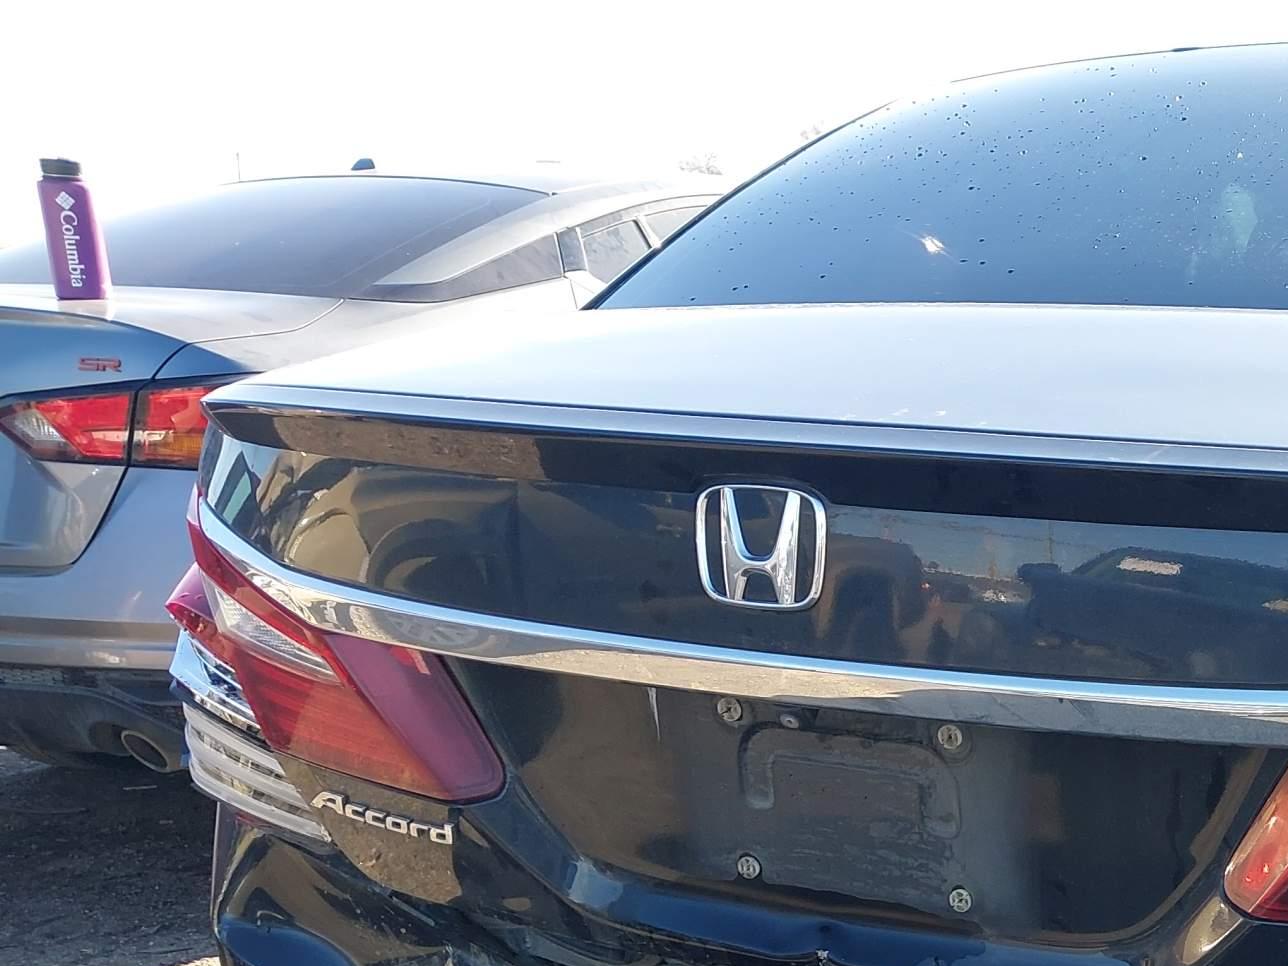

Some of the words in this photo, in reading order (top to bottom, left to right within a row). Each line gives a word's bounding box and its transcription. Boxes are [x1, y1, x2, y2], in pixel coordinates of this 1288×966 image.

[60, 210, 86, 288] Columbia
[78, 357, 122, 373] SR
[310, 791, 454, 845] Accord
